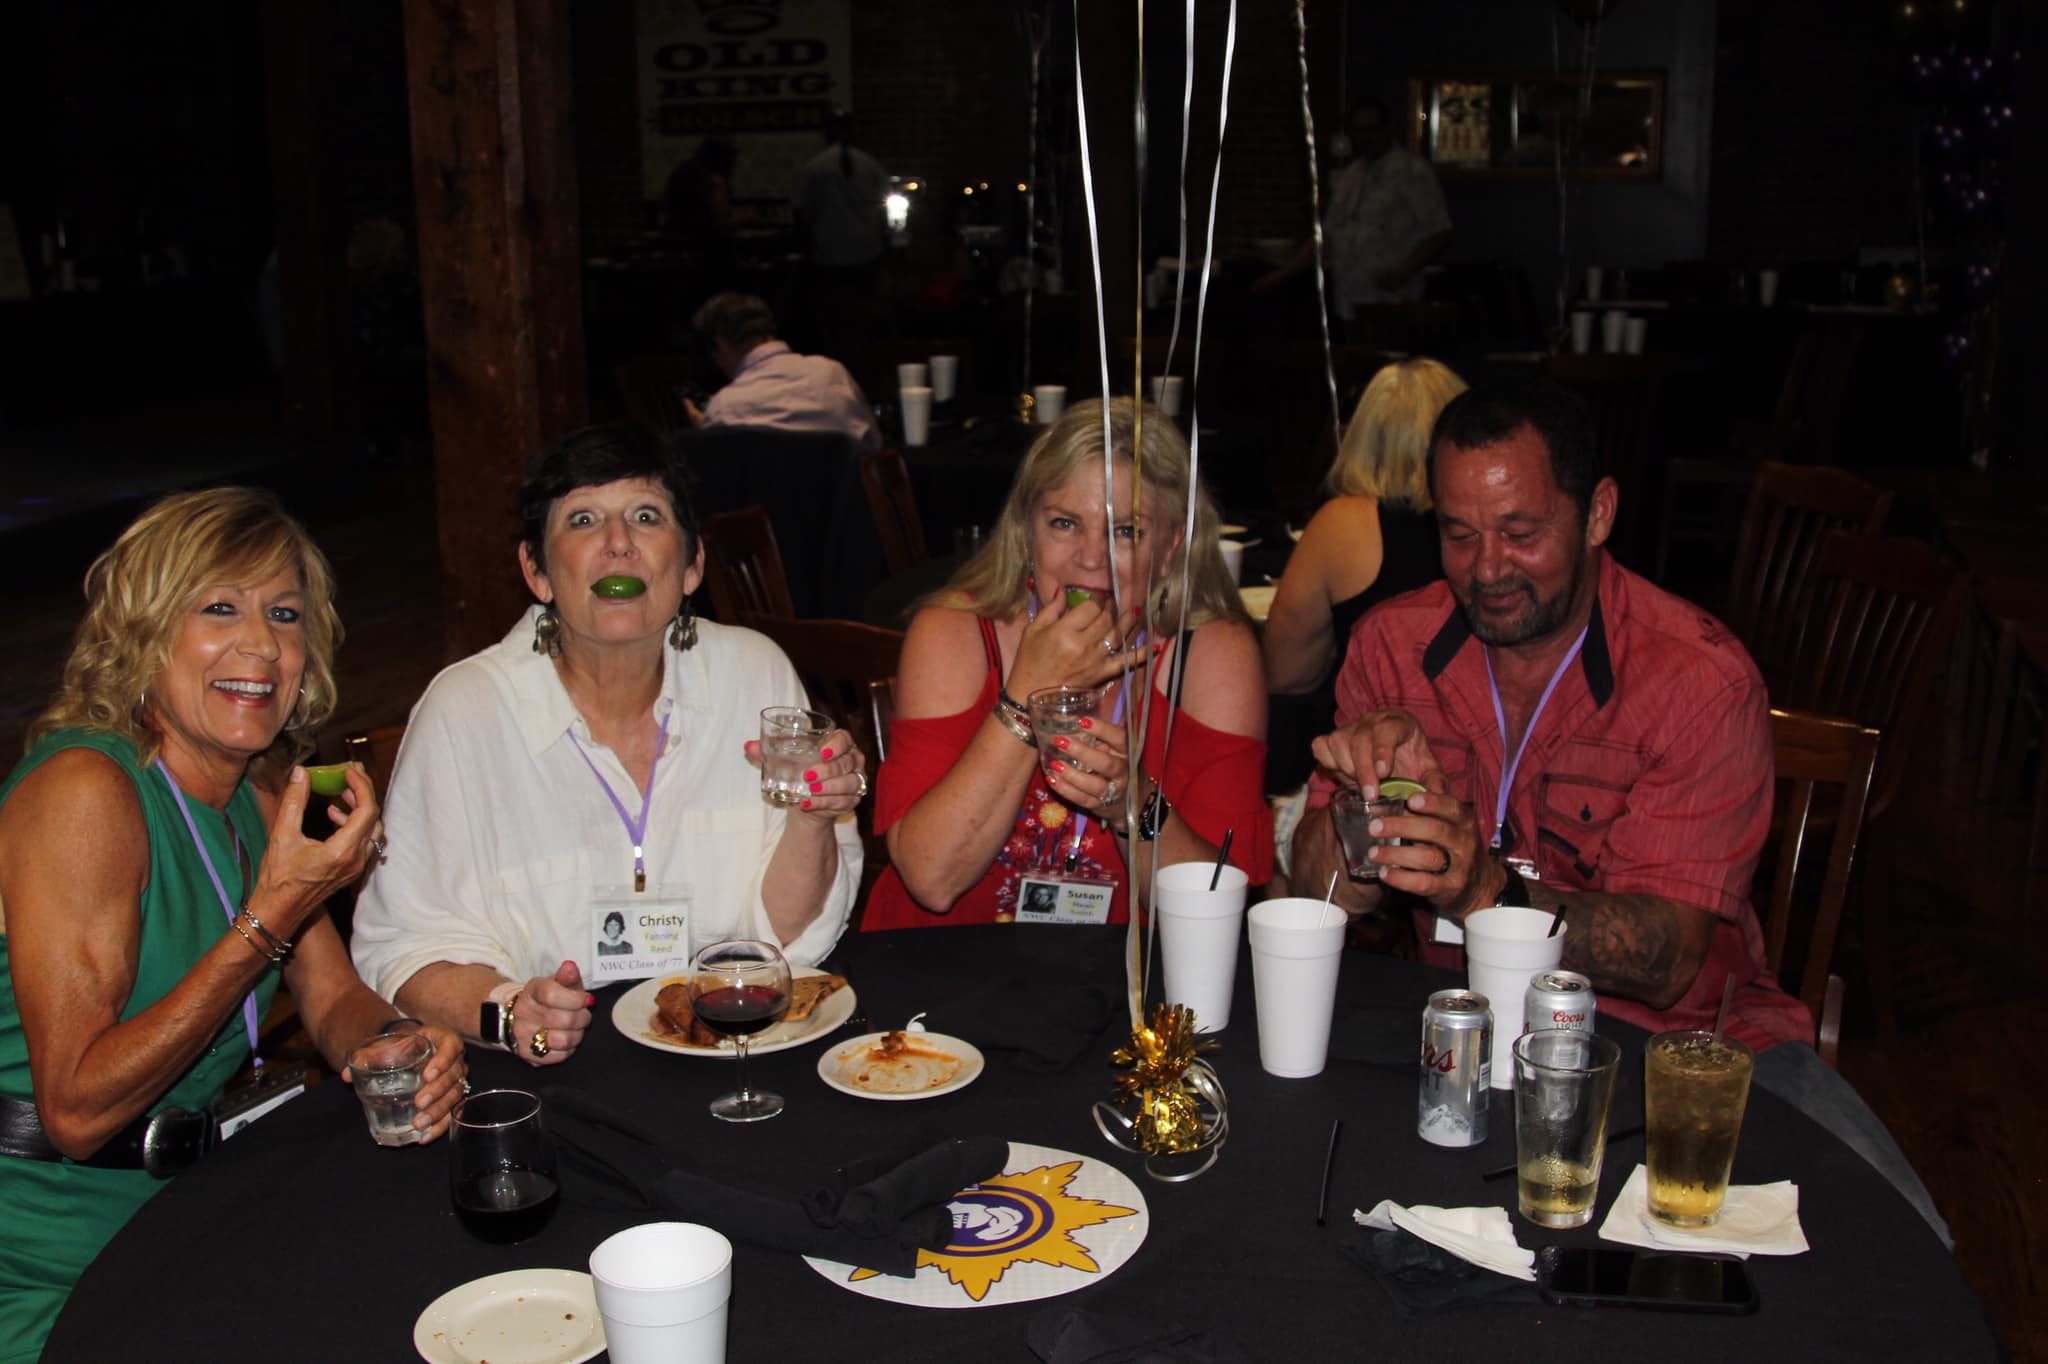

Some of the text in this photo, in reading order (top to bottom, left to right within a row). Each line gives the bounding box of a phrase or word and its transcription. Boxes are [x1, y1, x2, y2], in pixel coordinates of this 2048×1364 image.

[654, 38, 828, 71] OLD
[657, 73, 831, 97] KING
[1067, 890, 1104, 901] Susan
[639, 914, 685, 927] Christy
[600, 960, 626, 971] NWC
[629, 959, 655, 969] Class
[656, 959, 668, 968] of
[1553, 1010, 1584, 1023] Coors
[1556, 1022, 1582, 1030] LIGHT
